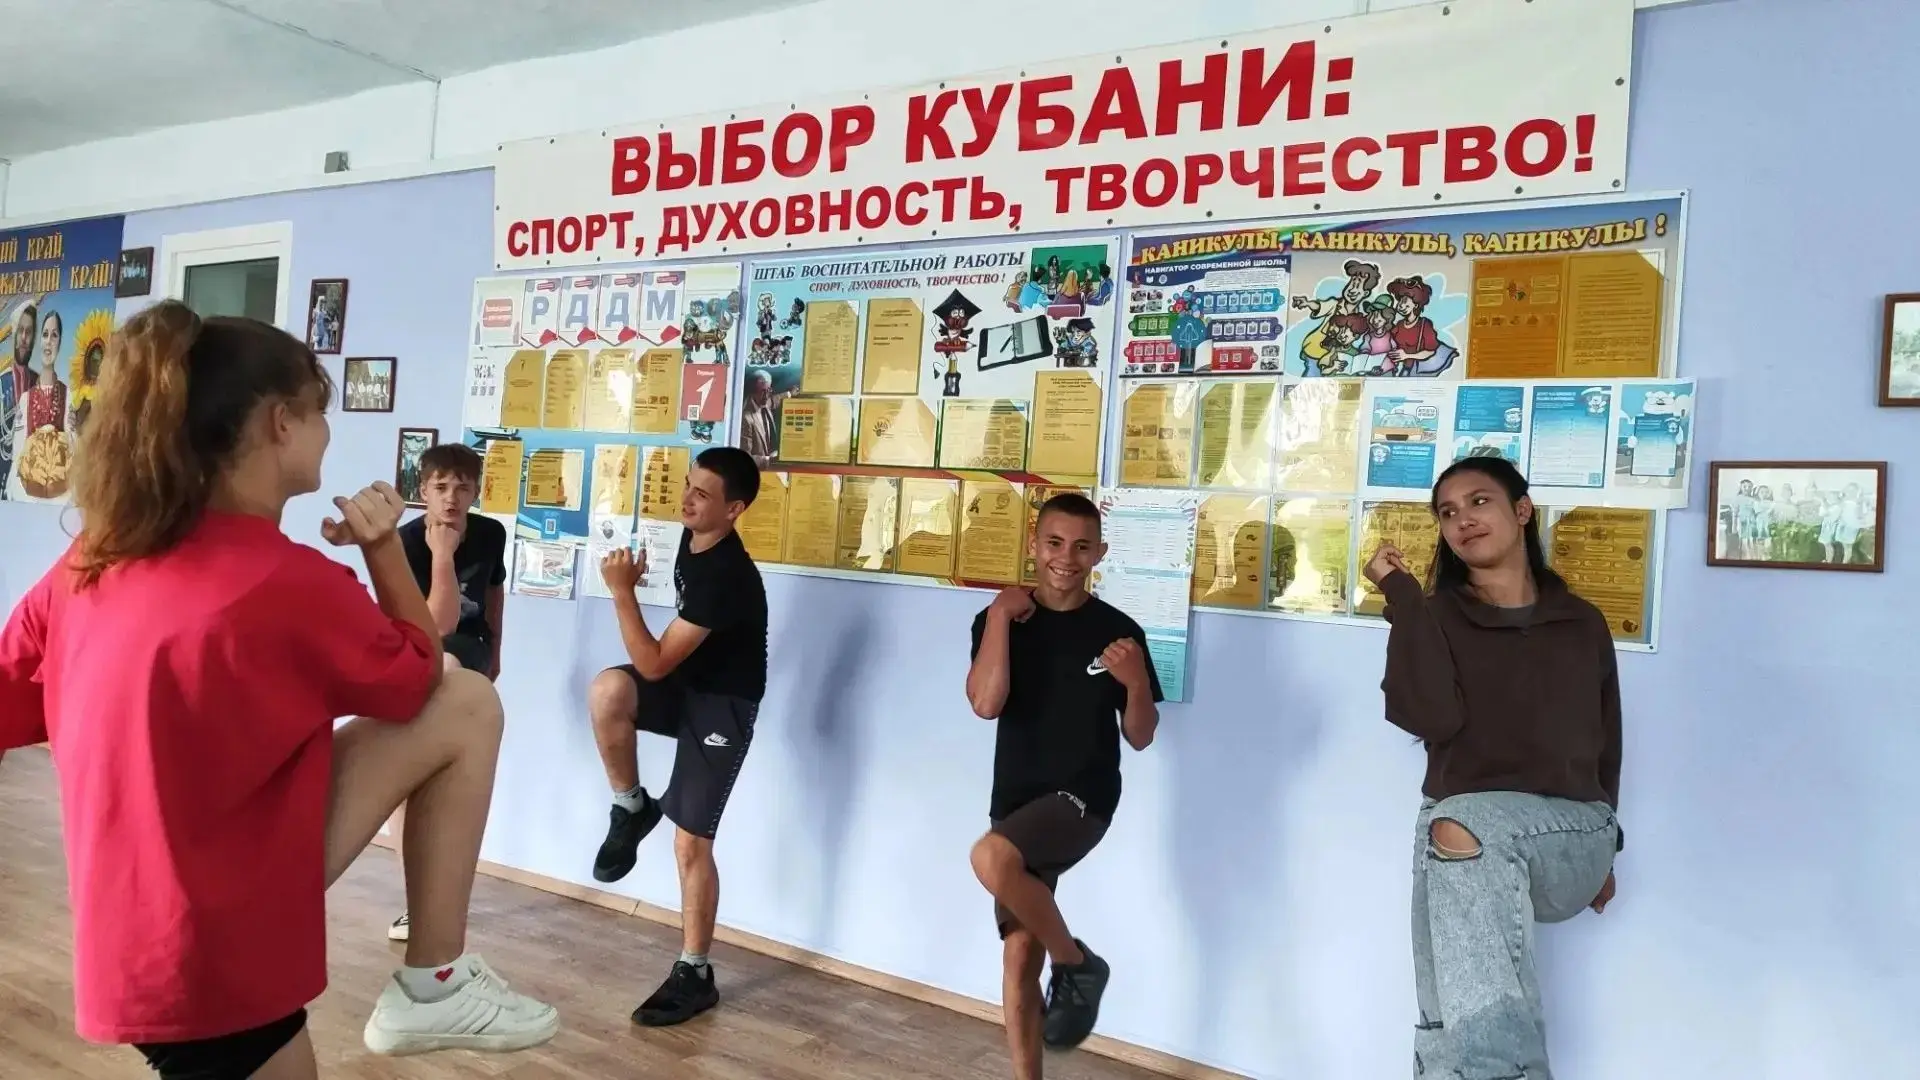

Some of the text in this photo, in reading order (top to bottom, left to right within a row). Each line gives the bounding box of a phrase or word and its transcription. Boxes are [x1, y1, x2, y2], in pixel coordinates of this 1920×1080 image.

[611, 40, 1355, 196] ВЫБОР КУБАНИ:
[507, 114, 1597, 258] СПОРТ, ДУХОВНОСТЬ, ТВОРЧЕСТВО!
[27, 231, 65, 261] КРАЙ,
[1140, 229, 1285, 264] КАНИКУЛЫ,
[1291, 231, 1456, 259] КАНИКУЛЫ,
[69, 258, 113, 290] КРАЙ!
[753, 250, 1026, 281] ШТАБ ВОСПИТАТЕЛЬНОЙ РАБОТЫ
[1144, 258, 1287, 274] НАВИГАТОР СОВРЕМЕННОЙ ШКОЛЫ
[809, 282, 845, 293] СПОРТ,
[848, 278, 921, 292] ДУХОВНОСТЬ,
[709, 732, 729, 744] NIKE
